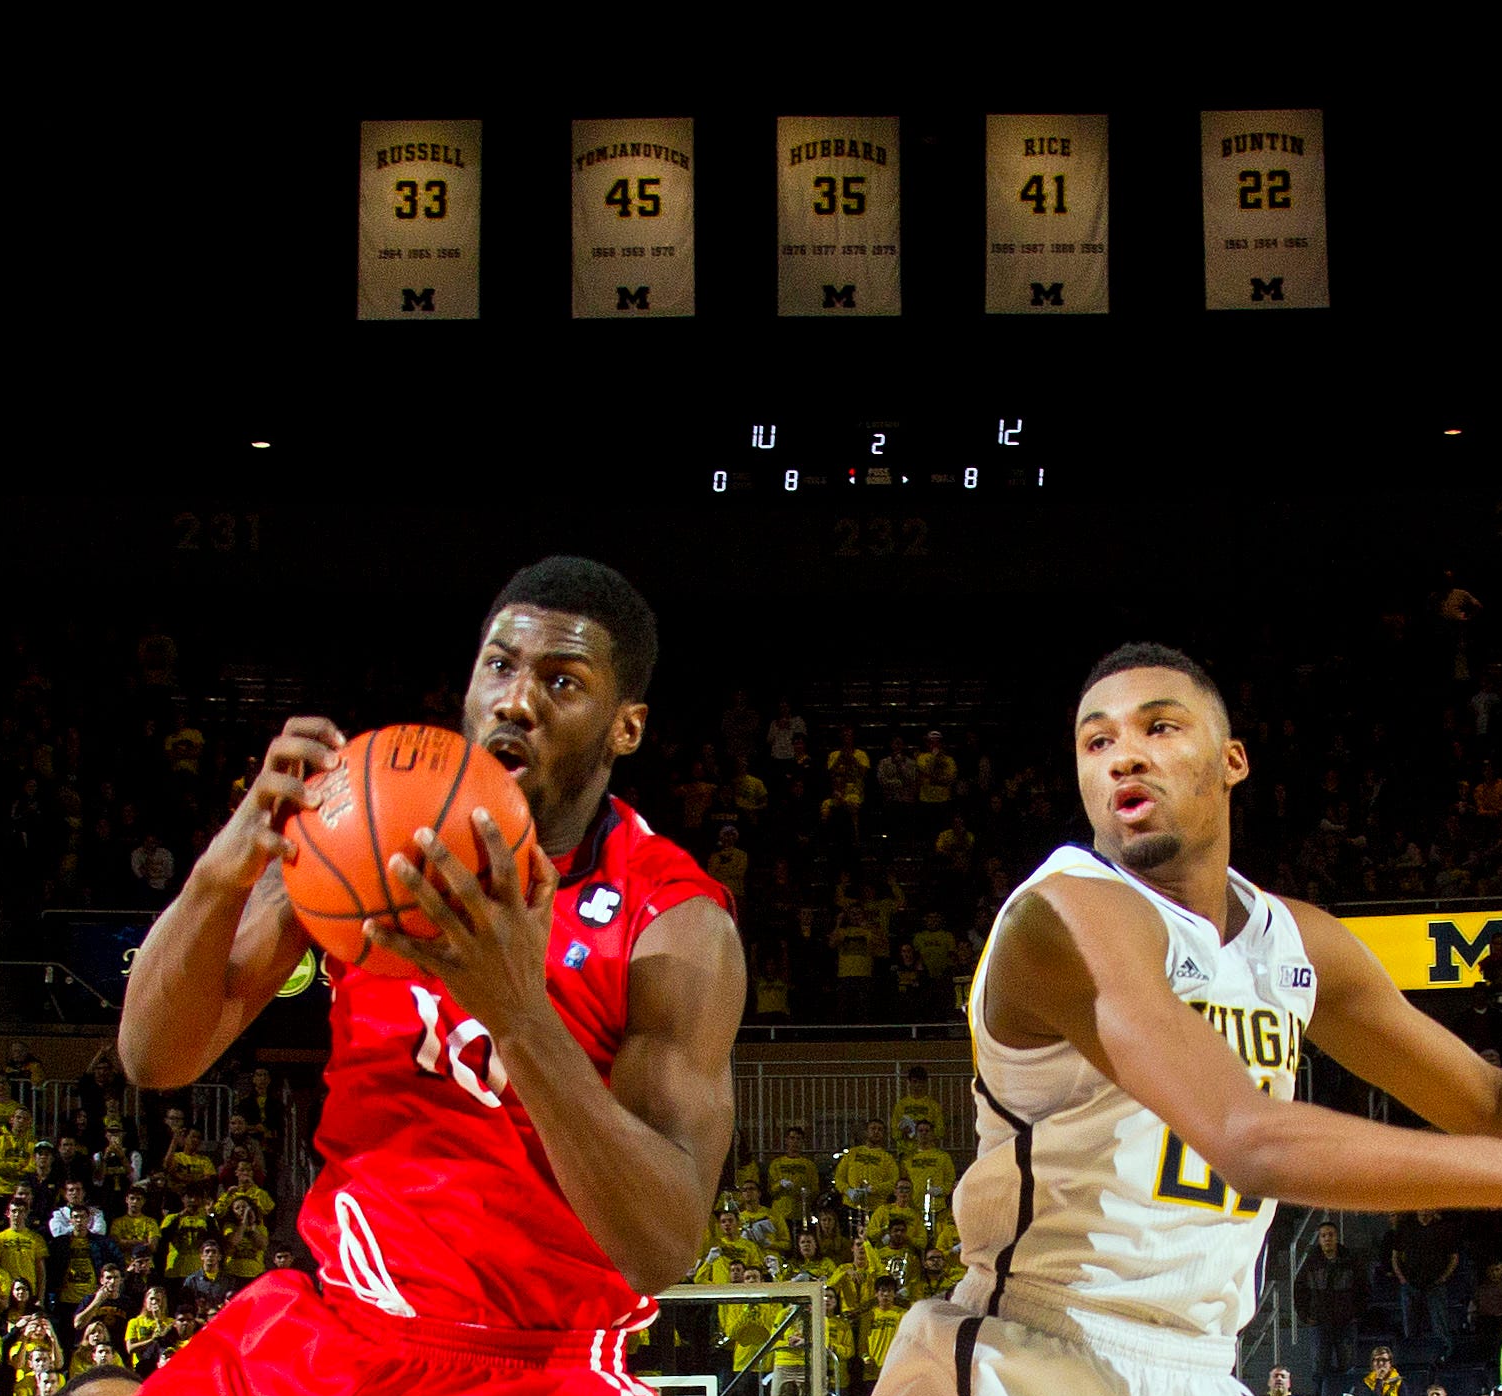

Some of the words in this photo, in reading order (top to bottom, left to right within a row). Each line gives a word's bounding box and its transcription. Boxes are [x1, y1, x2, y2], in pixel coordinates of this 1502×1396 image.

[377, 142, 465, 170] RUSSELL
[575, 142, 690, 172] TOMJANOVICH
[790, 138, 888, 167] HUBBARD
[1024, 137, 1072, 158] RICE
[1221, 132, 1306, 158] BUNTIN
[395, 178, 448, 220] 33
[605, 178, 662, 219] 45
[813, 175, 867, 216] 35
[1020, 173, 1069, 215] 41
[1238, 169, 1292, 211] 22
[401, 288, 435, 312] M
[616, 286, 651, 310] M
[822, 284, 856, 308] M
[1030, 282, 1064, 306] M
[1251, 276, 1285, 301] M
[870, 433, 886, 455] 2
[711, 470, 728, 493] 0
[783, 469, 800, 491] 8
[963, 467, 979, 490] 8
[172, 511, 261, 554] 231
[833, 517, 930, 557] 232
[409, 985, 508, 1108] 10
